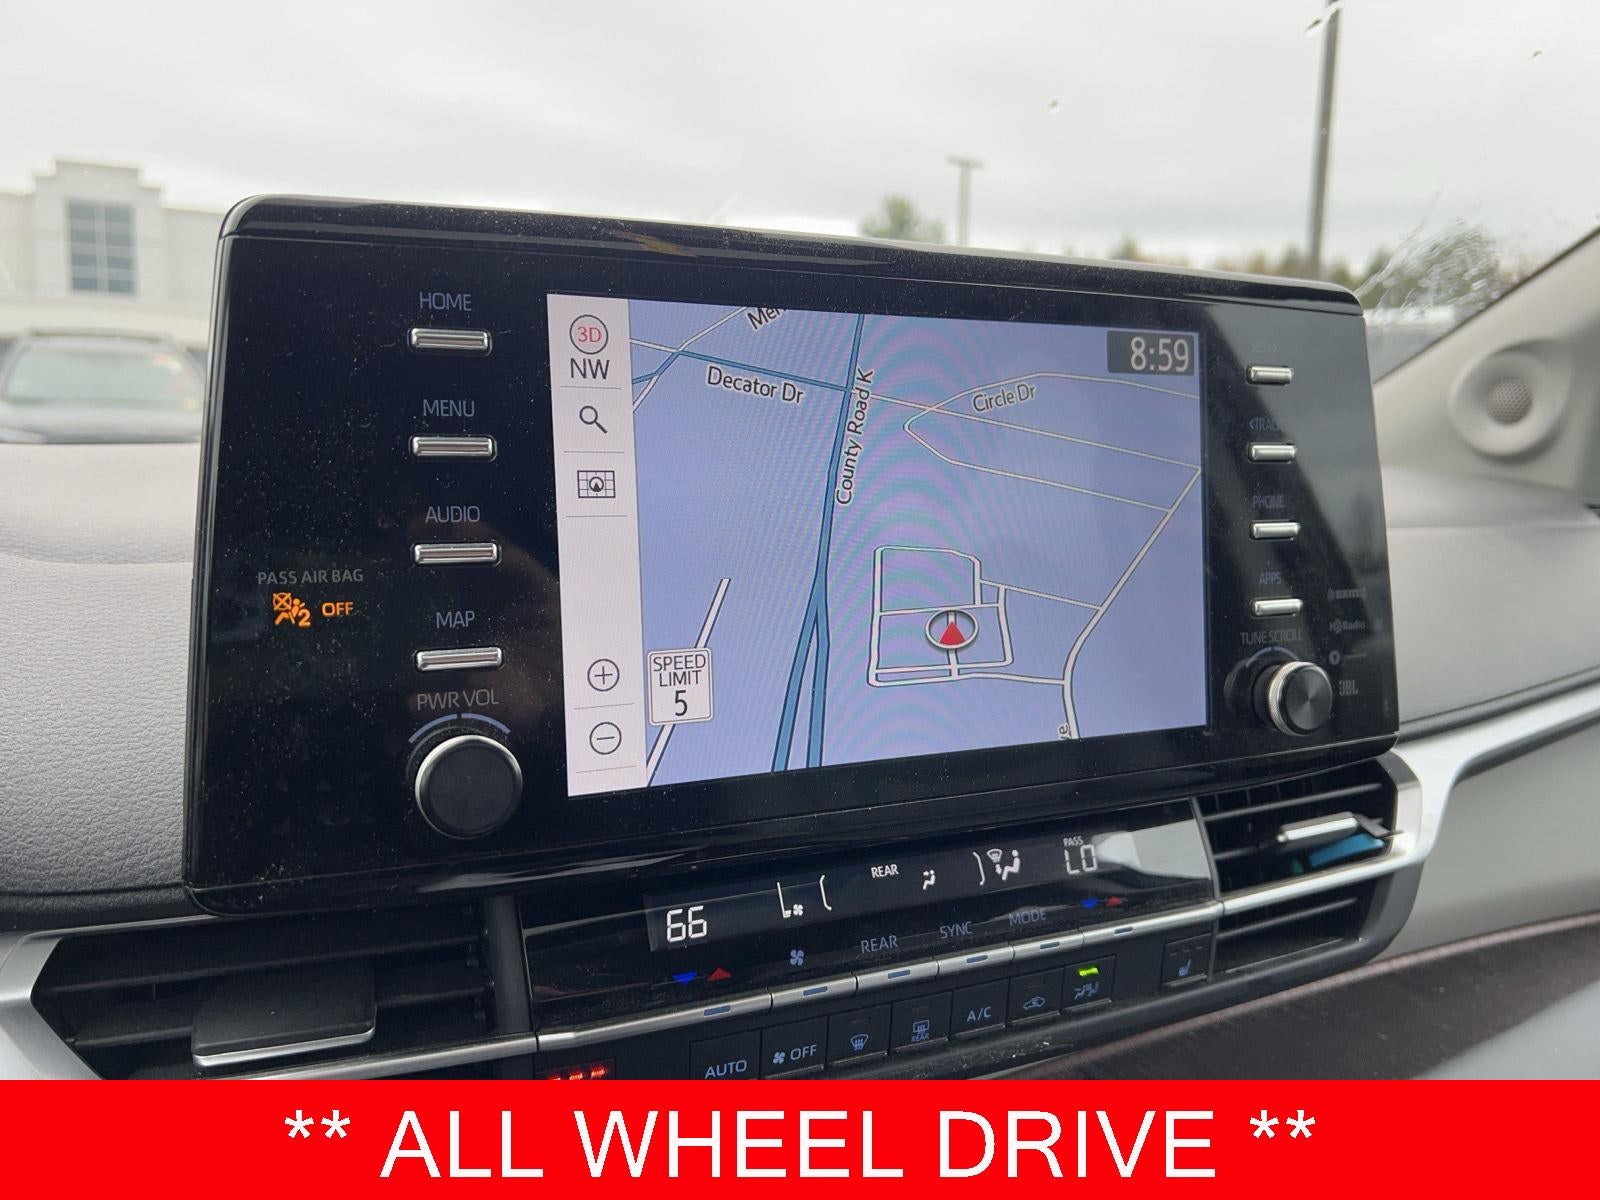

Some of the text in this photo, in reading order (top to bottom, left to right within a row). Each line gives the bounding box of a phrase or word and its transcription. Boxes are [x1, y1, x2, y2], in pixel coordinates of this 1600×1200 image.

[419, 292, 472, 312] HOME
[577, 326, 602, 343] 3D
[1130, 336, 1190, 372] 8:59
[570, 358, 610, 380] NW
[707, 365, 804, 404] Decator Dr
[972, 383, 1036, 412] Circle Dr
[423, 400, 475, 418] MENU
[836, 368, 875, 505] County Road K
[425, 505, 480, 523] AUDIO
[258, 568, 364, 585] PASS AIR BAG
[1258, 571, 1282, 585] APPS
[321, 602, 354, 617] OFF
[436, 611, 475, 629] MAP
[1240, 628, 1303, 646] TUNE SCROLL
[653, 654, 707, 672] SPEED
[659, 670, 702, 687] LIMIT
[417, 688, 499, 711] PWR VOL
[674, 689, 688, 717] 5
[1062, 836, 1084, 847] PASS
[871, 863, 899, 879] REAR
[666, 905, 708, 943] 66
[1008, 909, 1048, 927] MODE
[940, 921, 973, 940] SYNC
[861, 935, 899, 953] REAR
[966, 1006, 992, 1023] A/C
[911, 1032, 930, 1042] REAR
[790, 1044, 818, 1061] OFF
[704, 1060, 748, 1079] AUTO
